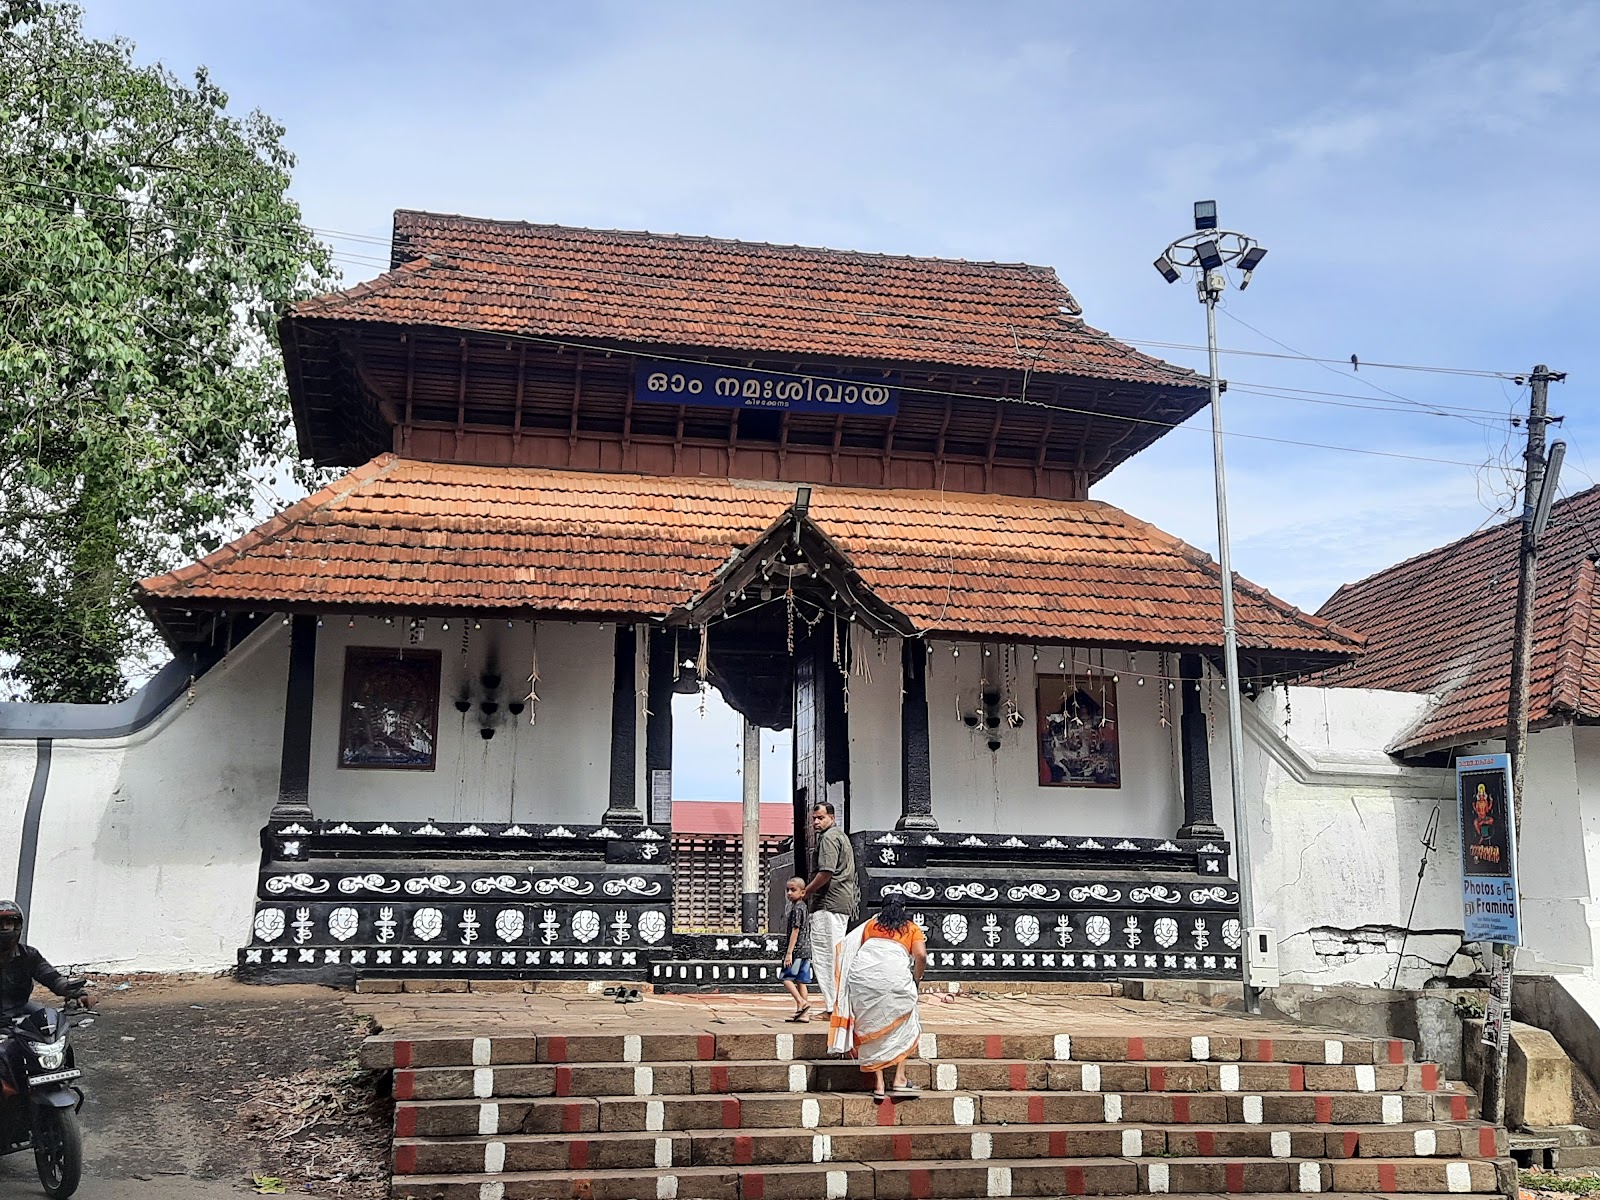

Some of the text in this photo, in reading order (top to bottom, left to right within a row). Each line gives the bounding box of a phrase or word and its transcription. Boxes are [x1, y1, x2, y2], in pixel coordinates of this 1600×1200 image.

[647, 372, 703, 394] ഓം
[1464, 879, 1502, 896] Photos &
[1476, 898, 1514, 918] Framing
